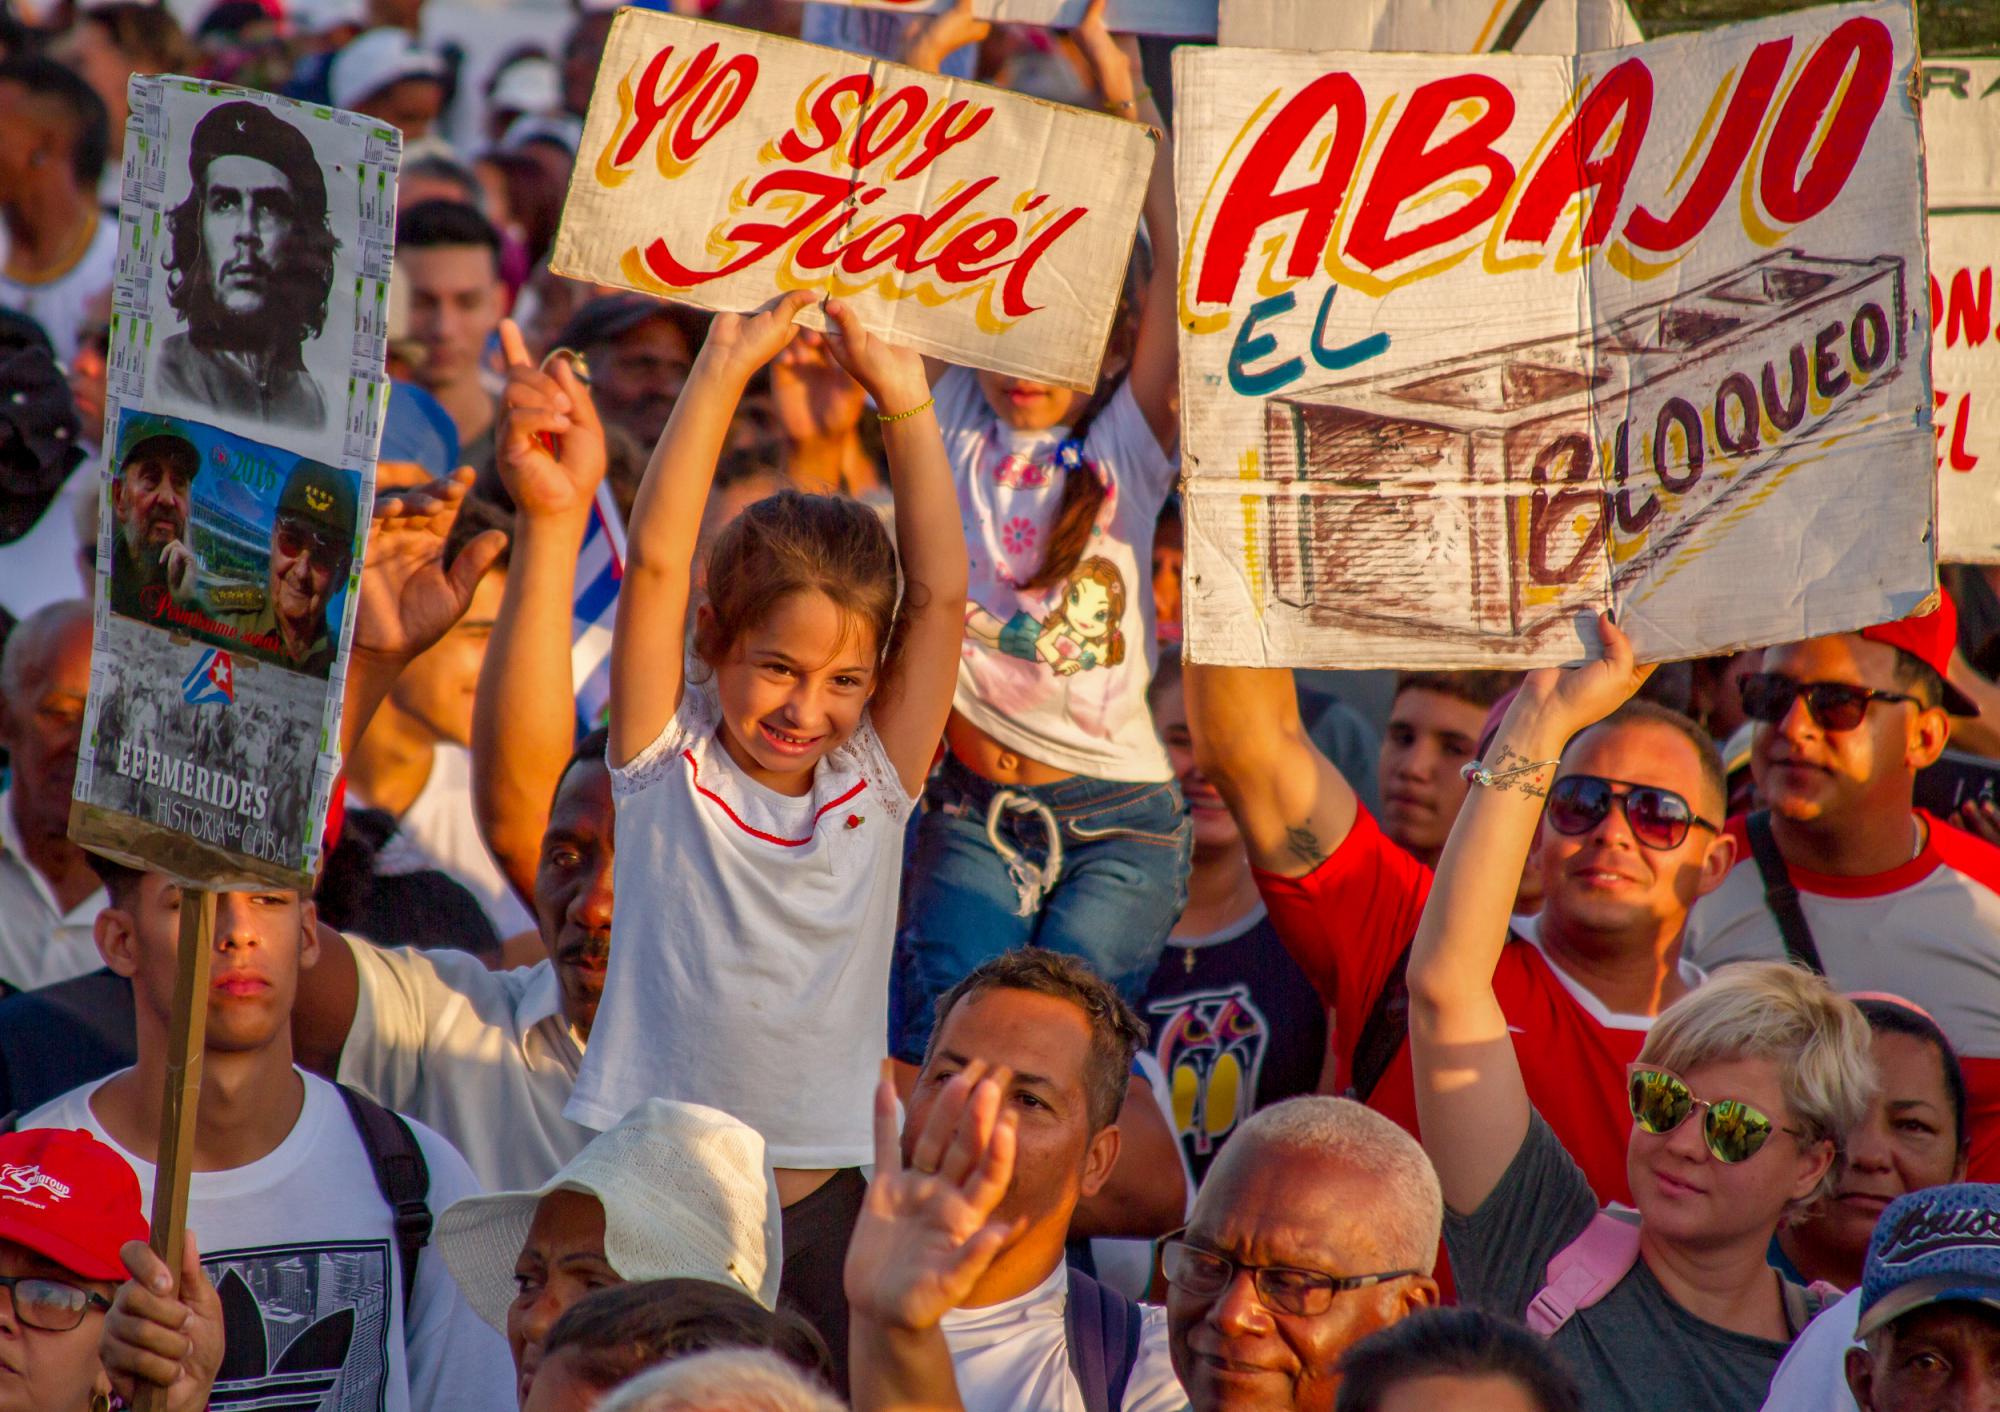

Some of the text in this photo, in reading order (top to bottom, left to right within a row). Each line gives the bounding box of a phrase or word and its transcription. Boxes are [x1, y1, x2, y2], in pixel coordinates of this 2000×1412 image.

[614, 42, 994, 180] YO SOY
[1921, 65, 2000, 101] R
[1195, 17, 1894, 305] ABAJO
[1227, 284, 1391, 396] EL
[1528, 302, 1891, 586] BLOQUEO
[116, 738, 268, 820] EFEMÉRIDES
[156, 795, 288, 866] HISTORIA de CUBA
